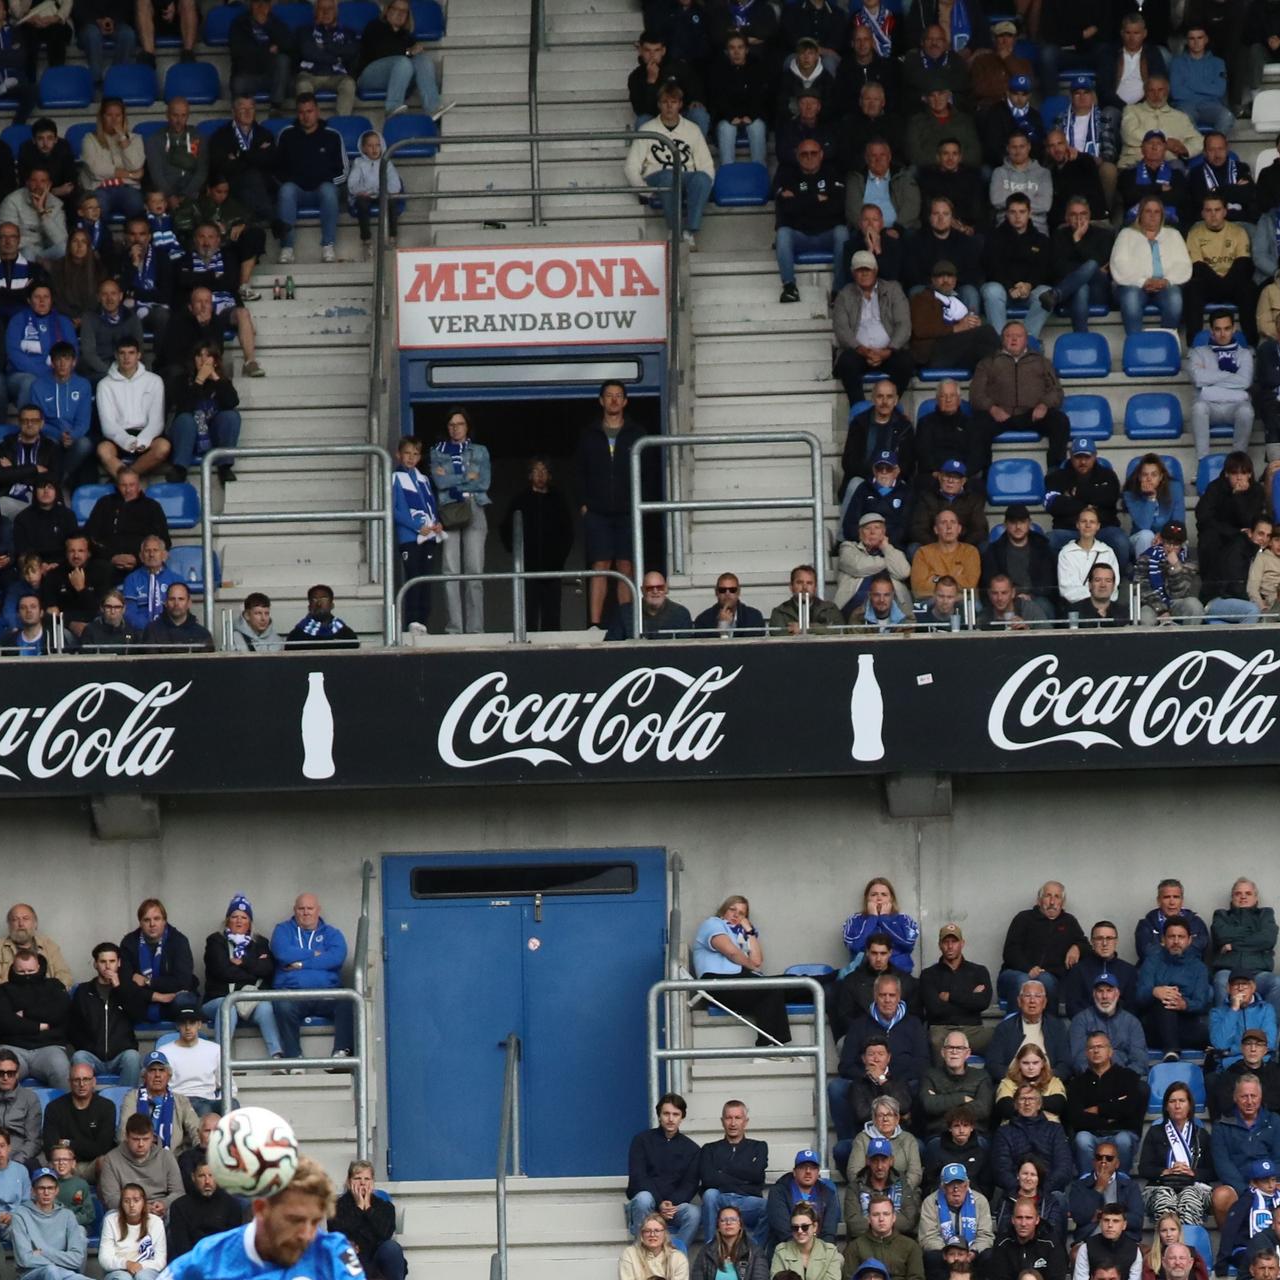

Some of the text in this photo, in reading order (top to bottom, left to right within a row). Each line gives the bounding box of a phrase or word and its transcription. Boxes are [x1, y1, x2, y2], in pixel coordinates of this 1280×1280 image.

[404, 257, 659, 303] MECONA
[428, 309, 637, 334] VERANDABOUW
[438, 665, 743, 768] Coca-Cola
